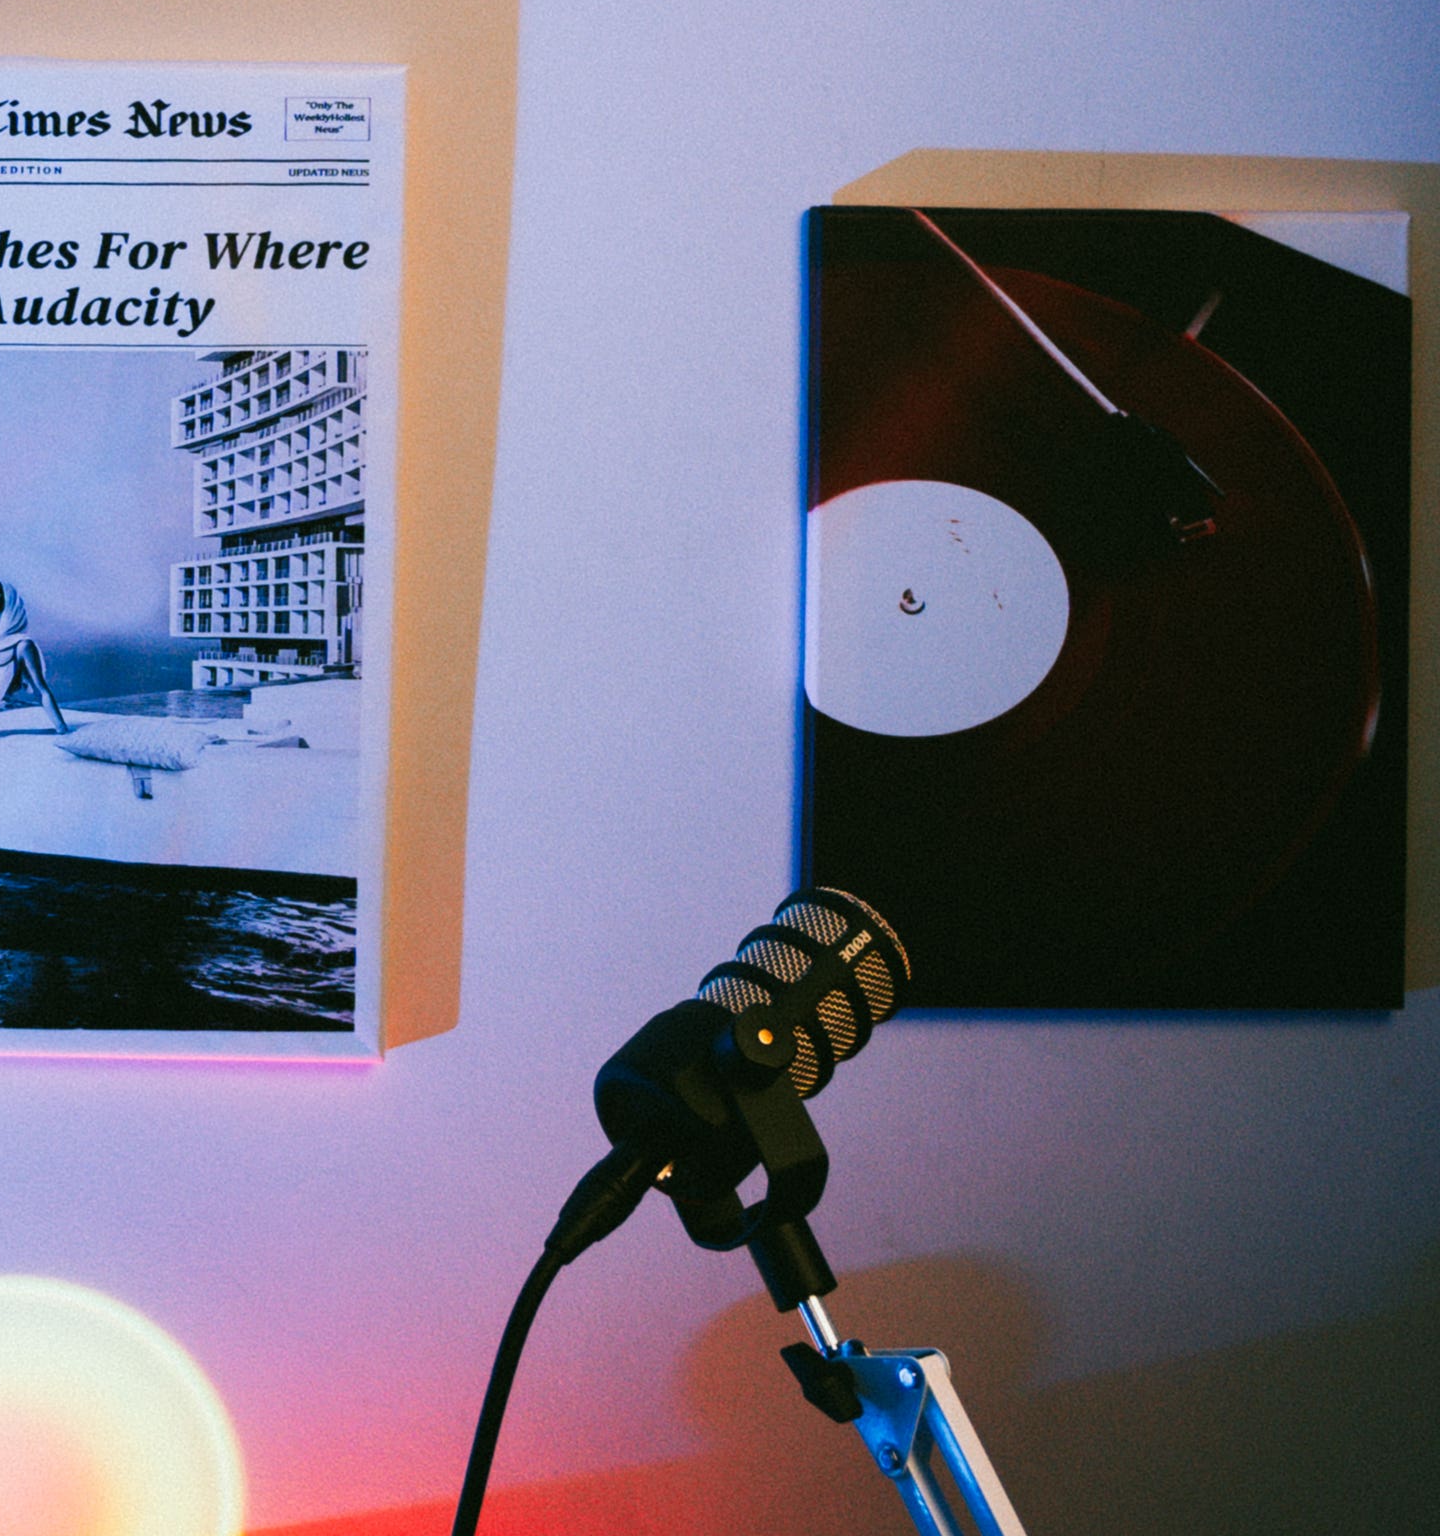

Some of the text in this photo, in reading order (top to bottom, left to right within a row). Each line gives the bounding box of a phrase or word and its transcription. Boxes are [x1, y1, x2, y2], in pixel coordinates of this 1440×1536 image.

[123, 98, 253, 139] News
[0, 165, 63, 175] EDITION
[288, 168, 340, 177] UPDATED
[93, 232, 188, 270] For
[203, 230, 370, 270] Where
